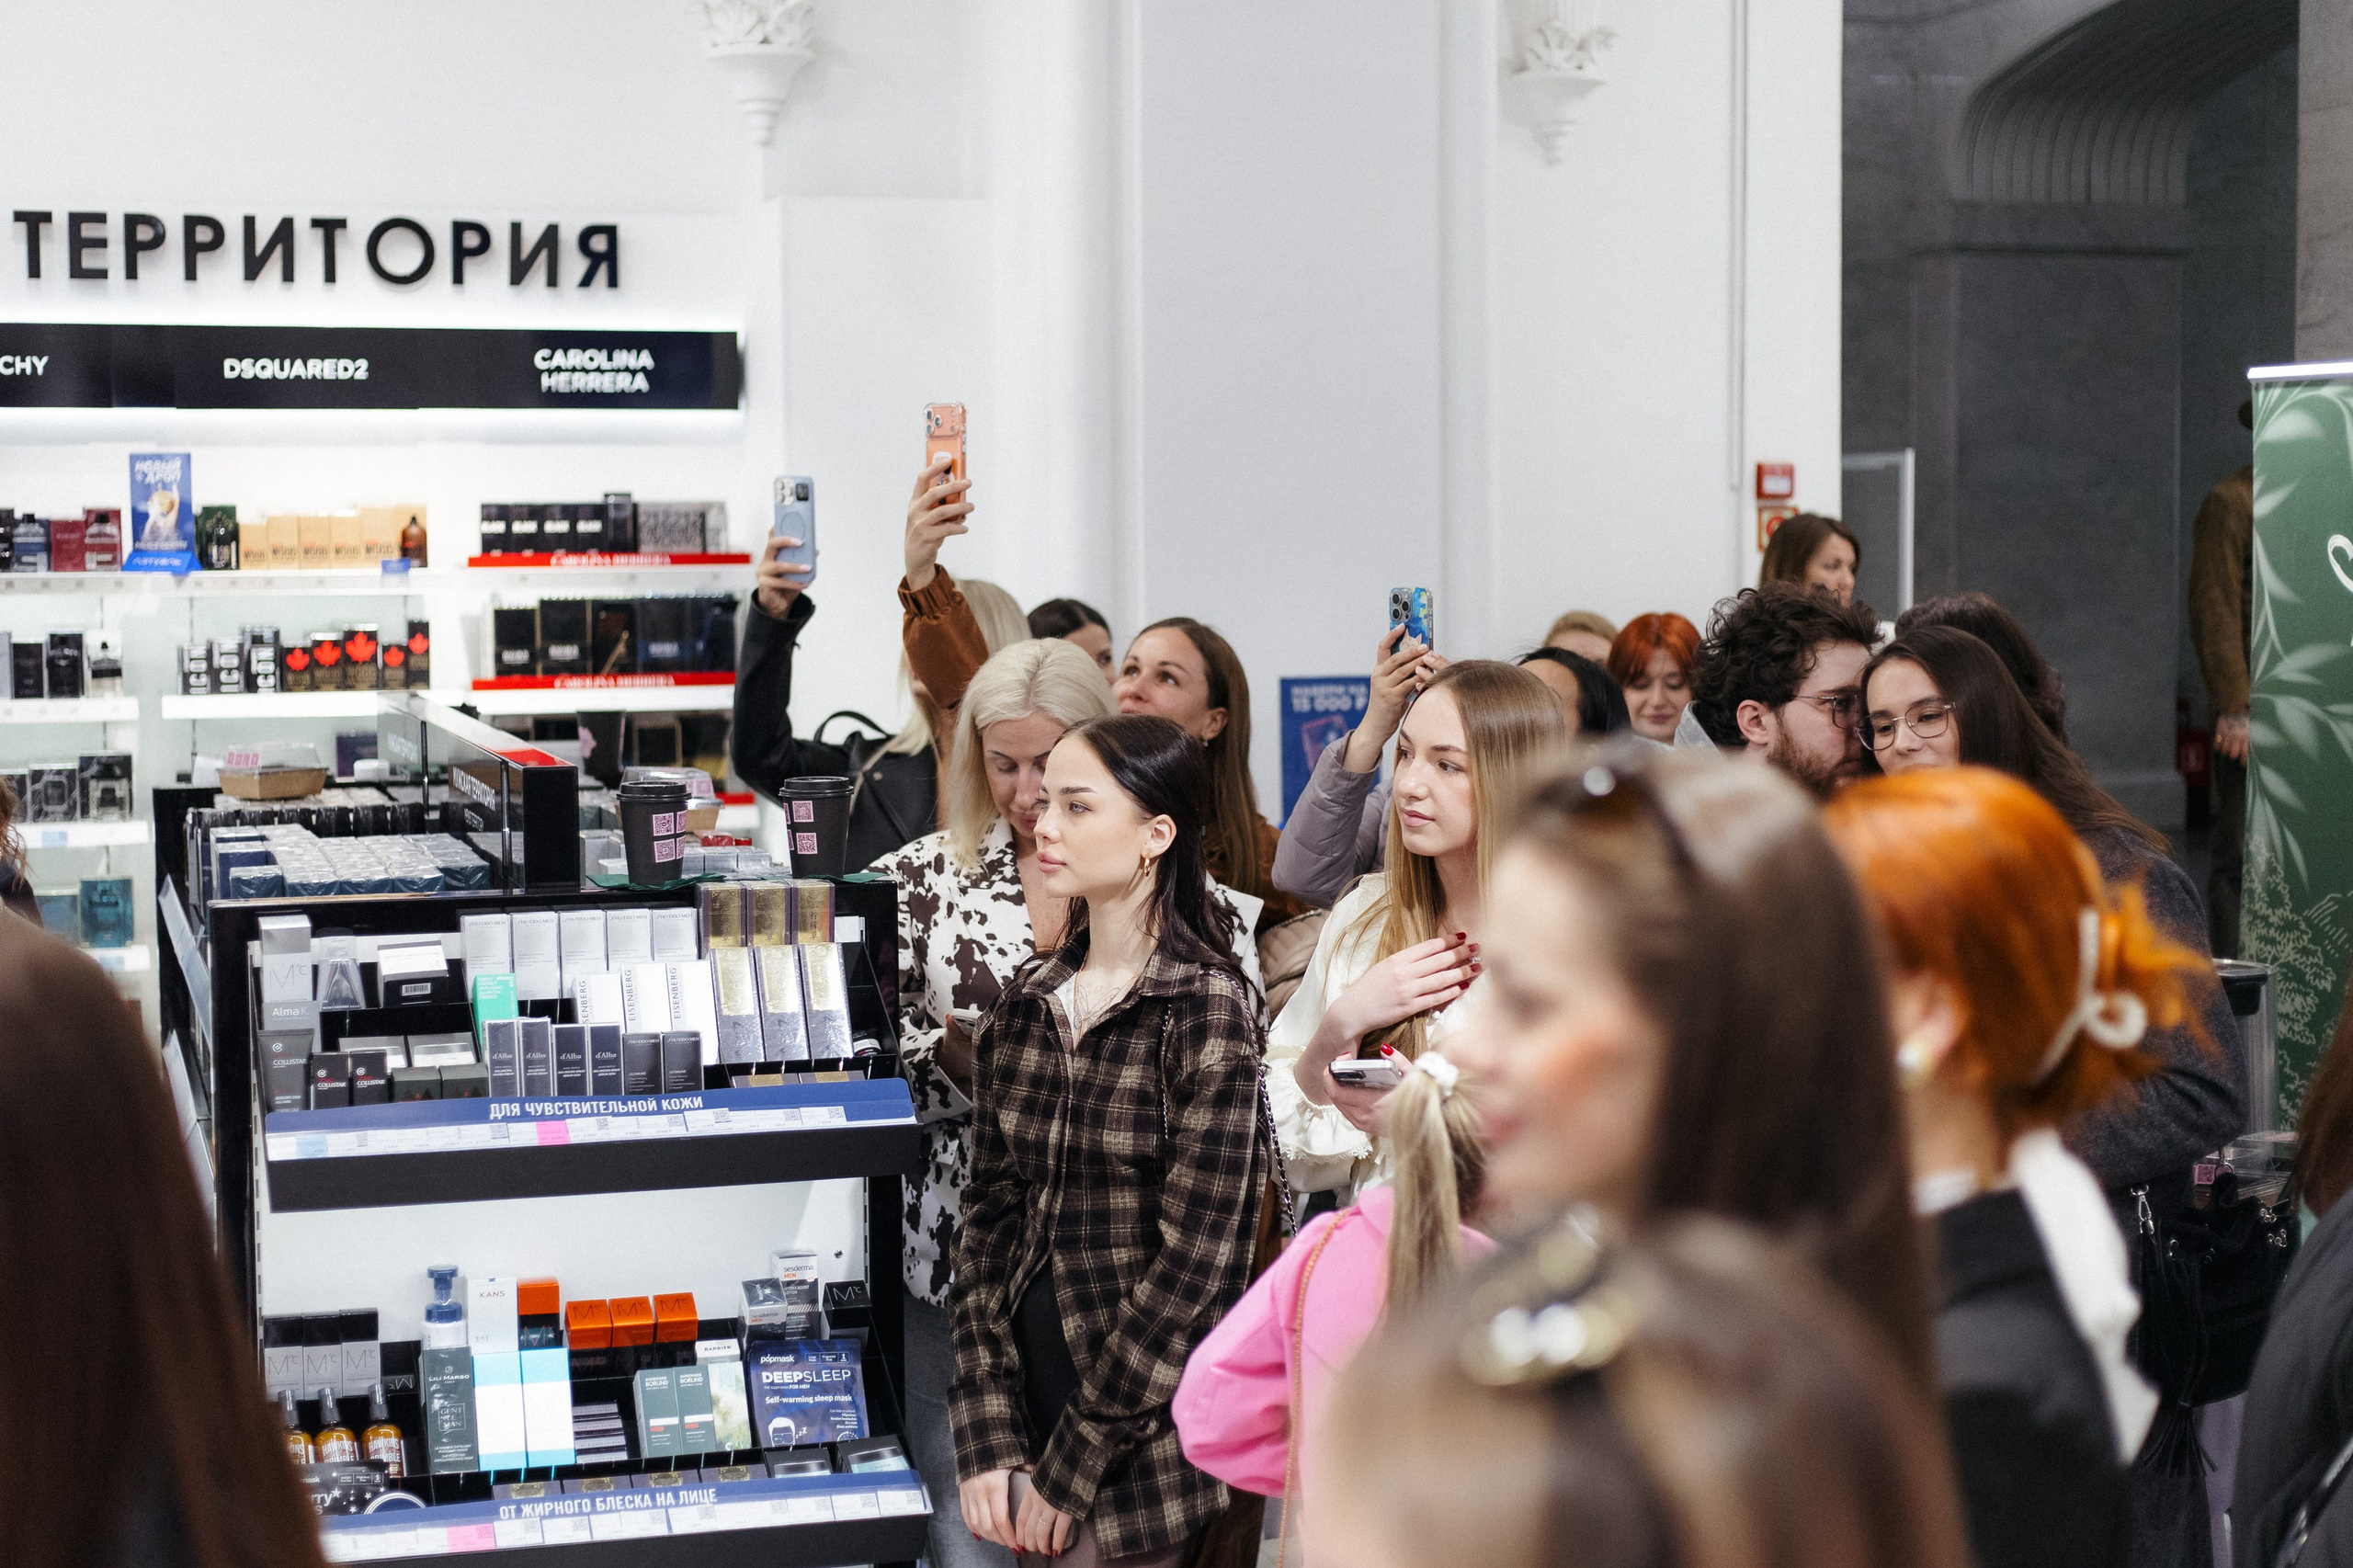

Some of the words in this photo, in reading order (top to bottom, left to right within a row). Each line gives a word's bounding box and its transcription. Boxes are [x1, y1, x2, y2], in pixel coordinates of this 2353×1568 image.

[13, 210, 619, 288] ТЕРРИТОРИЯ
[223, 358, 369, 380] DSQUARED2
[533, 348, 655, 369] CAROLINA
[540, 371, 650, 392] HERRERA
[579, 981, 589, 1024] SENBERG
[625, 970, 635, 1021] EISENBERG
[670, 967, 681, 1019] EISENBERG
[272, 1007, 300, 1017] Alma
[490, 1103, 521, 1119] ДЛЯ
[525, 1098, 657, 1116] ЧУВСТВИТЕЛЬНОЙ
[662, 1096, 703, 1110] КОЖИ
[761, 1369, 851, 1383] DEEPSLEEP
[766, 1396, 813, 1404] Self-warming
[814, 1394, 834, 1403] sleep
[323, 1439, 353, 1456] HAWKINS
[369, 1437, 399, 1452] HAWKINS
[312, 1493, 332, 1506] rry
[499, 1505, 517, 1519] ОТ
[521, 1499, 591, 1518] ЖИРНОГО
[597, 1494, 652, 1512] БЛЕСКА
[656, 1492, 676, 1506] НА
[678, 1489, 718, 1506] ЛИЦЕ
